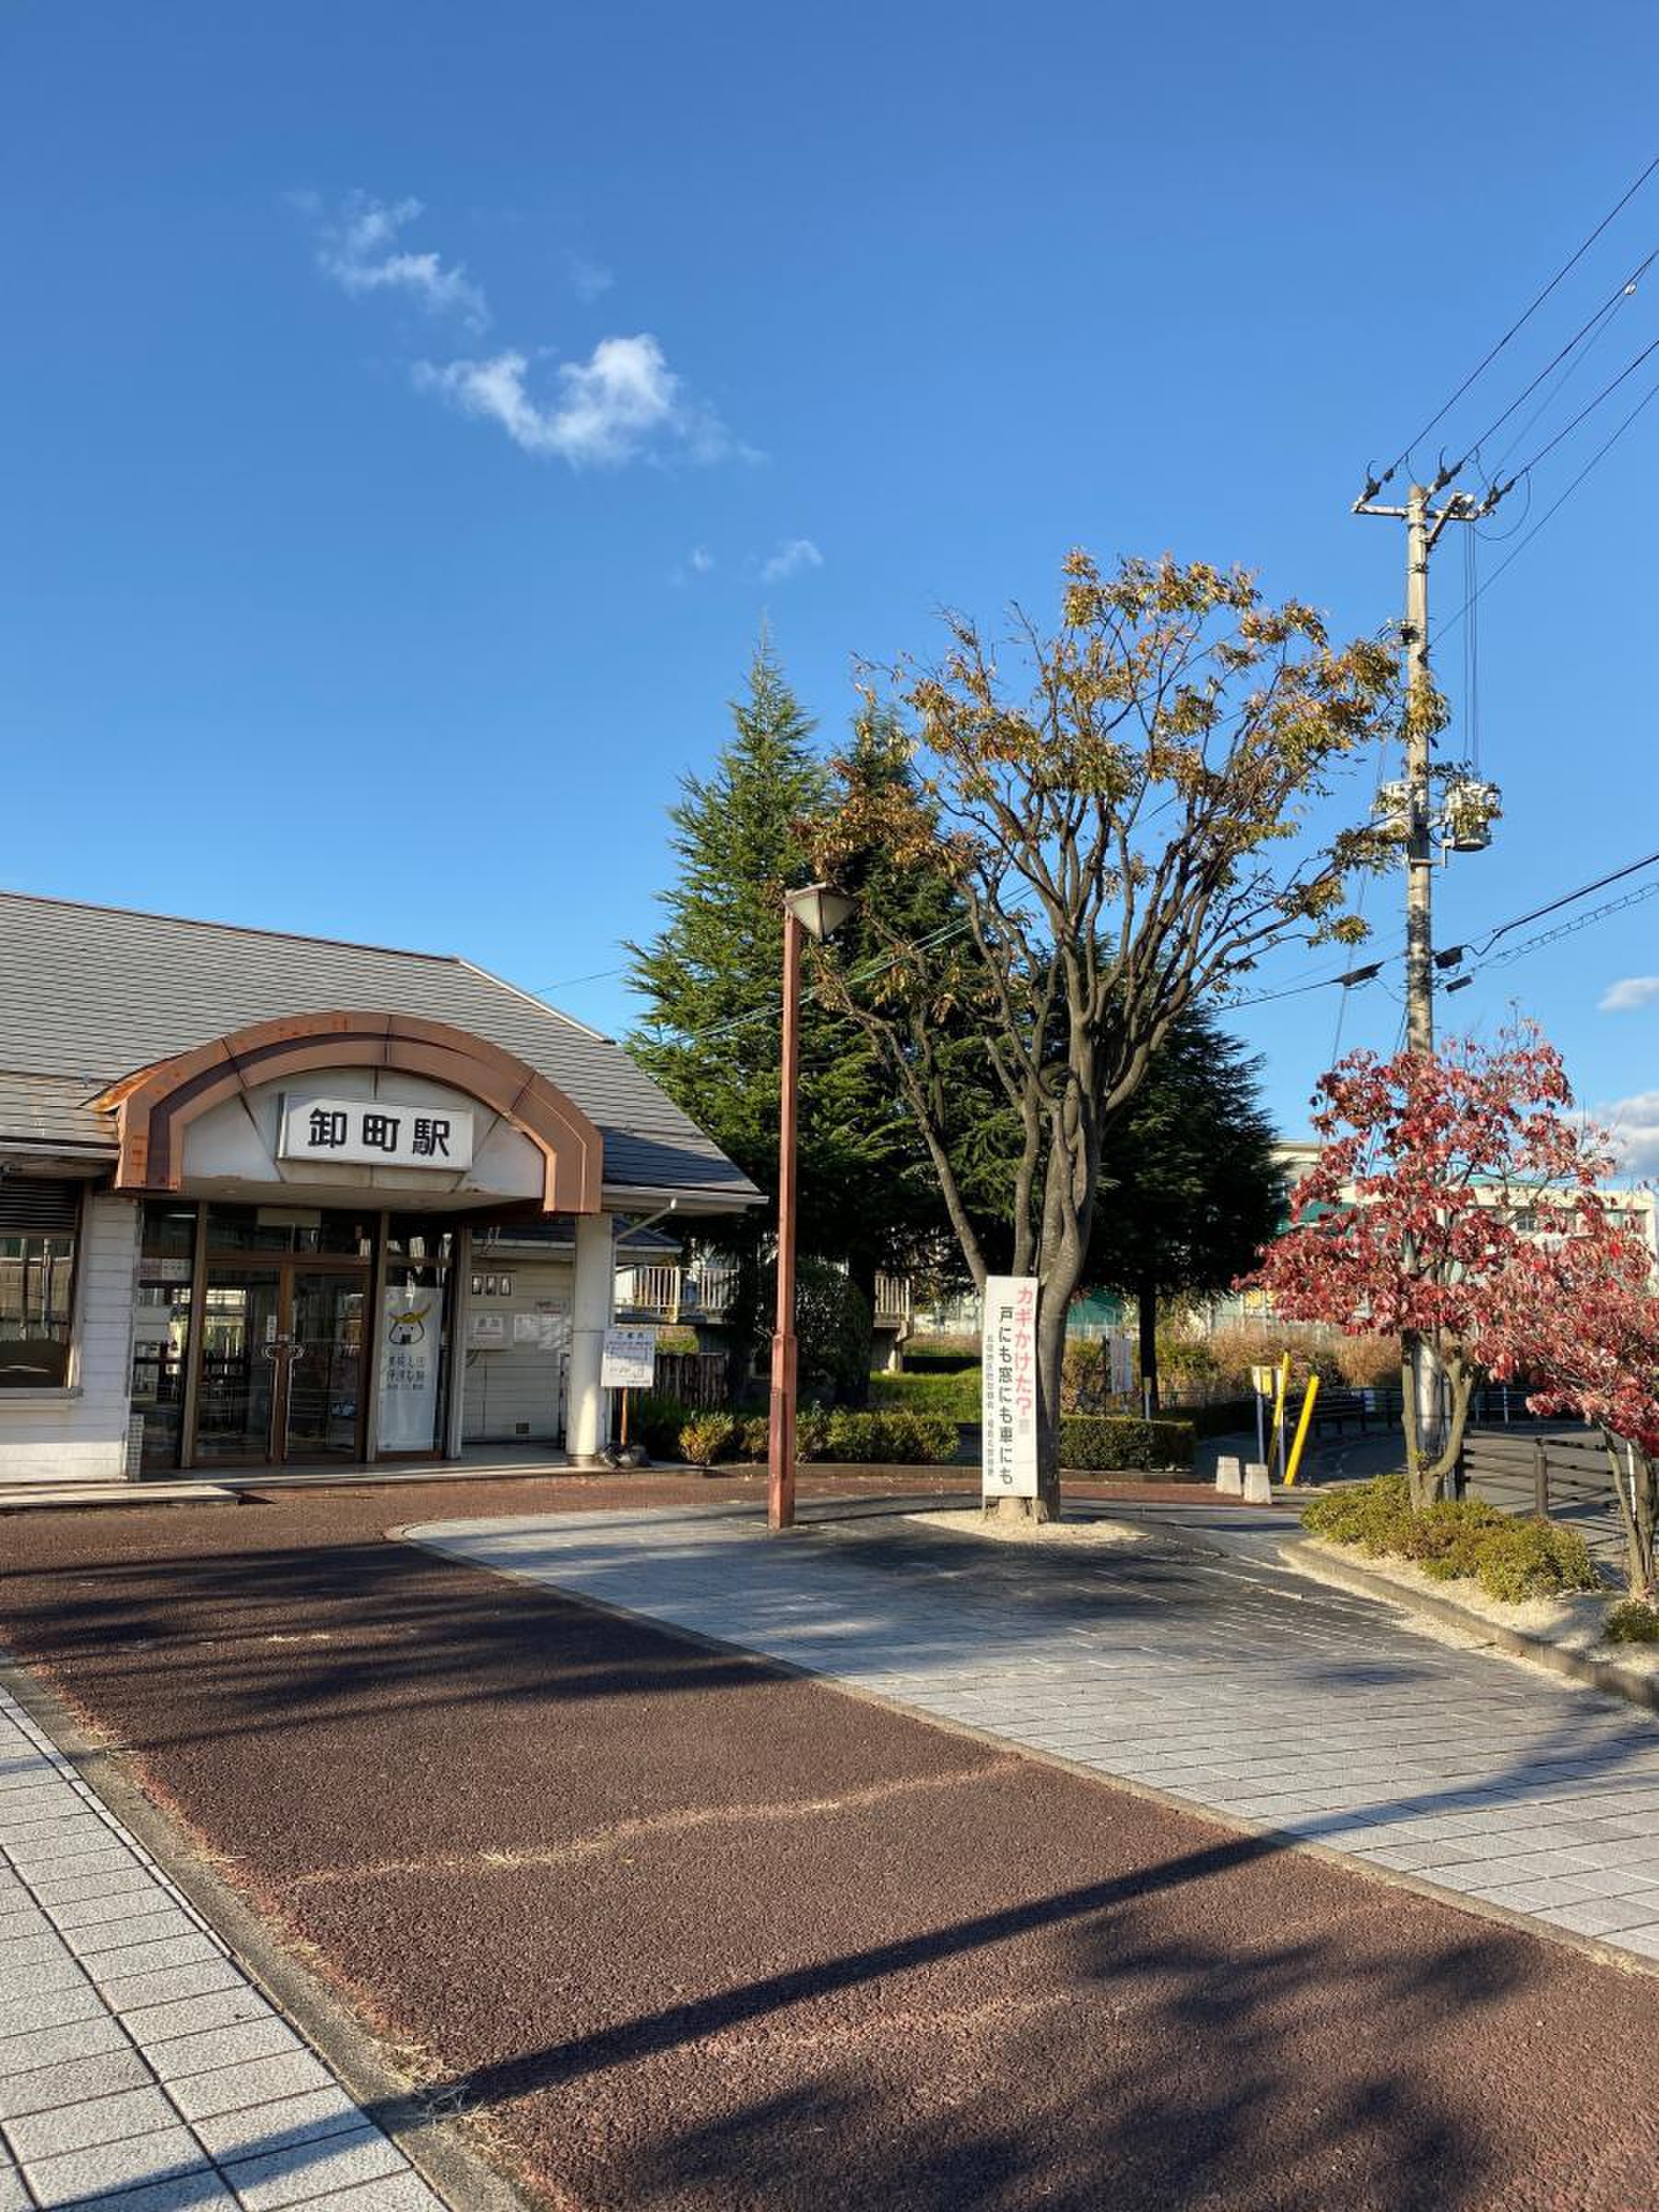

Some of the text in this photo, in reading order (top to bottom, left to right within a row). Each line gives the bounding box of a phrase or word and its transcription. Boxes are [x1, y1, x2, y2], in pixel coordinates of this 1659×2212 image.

[308, 1108, 450, 1157] 卸町駅
[999, 1306, 1014, 1485] 戸にも窓にも車にも
